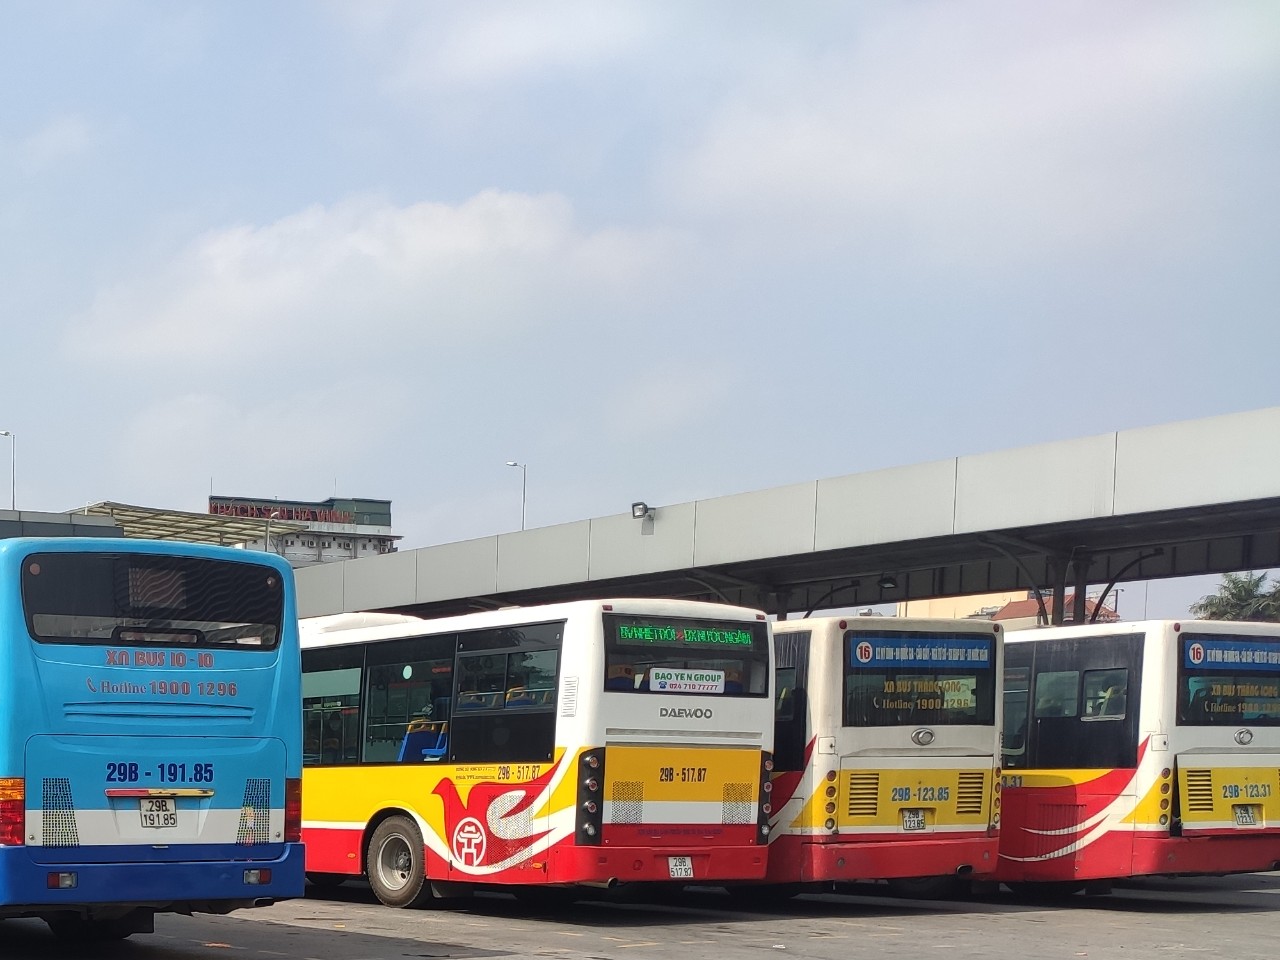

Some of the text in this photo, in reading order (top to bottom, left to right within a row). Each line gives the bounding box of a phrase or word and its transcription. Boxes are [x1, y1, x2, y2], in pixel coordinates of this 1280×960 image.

[134, 651, 166, 667] BUS
[858, 645, 870, 660] 16
[1191, 647, 1201, 661] 16
[654, 672, 673, 681] BAO
[693, 673, 722, 682] GROUP
[100, 680, 238, 697] Hotline 1900 1296
[896, 680, 912, 693] BUS
[882, 698, 969, 710] Hotline 1900 1296
[659, 707, 713, 719] DAEWOO
[105, 762, 139, 783] 29B
[157, 763, 214, 783] 191.85
[498, 765, 510, 780] 29B
[517, 765, 541, 780] 517.87
[659, 767, 674, 782] 29B
[681, 767, 707, 783] 517.87
[1001, 775, 1023, 788] 3.31
[148, 799, 169, 812] 29B
[143, 813, 176, 826] 191.85
[673, 857, 687, 867] 29B
